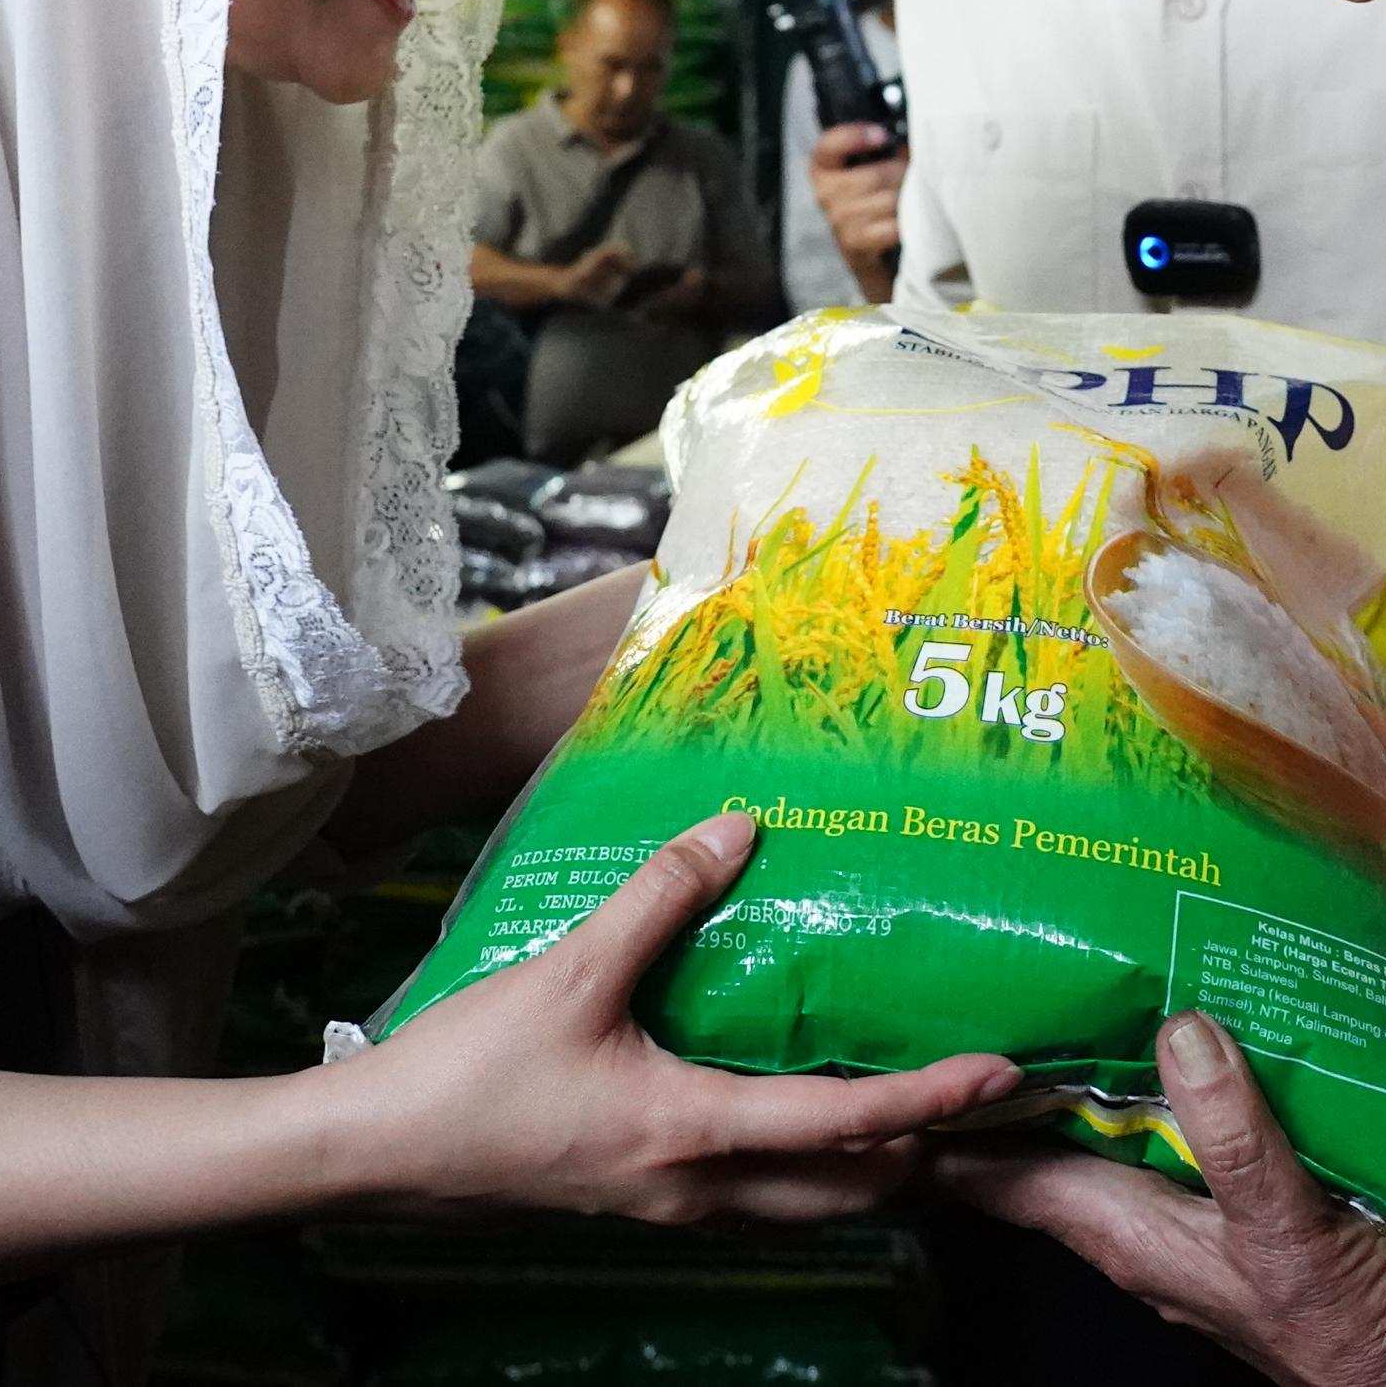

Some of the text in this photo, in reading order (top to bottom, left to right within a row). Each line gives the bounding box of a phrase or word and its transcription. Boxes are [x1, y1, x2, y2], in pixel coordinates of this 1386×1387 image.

[883, 608, 1110, 649] Berat Bersih/Netto:
[902, 640, 1069, 743] 5 kg
[900, 804, 1001, 846] Beras
[1010, 817, 1222, 887] Pemerintah
[502, 871, 558, 890] PERUM
[494, 897, 524, 914] JL.
[1251, 934, 1280, 953] HET
[1283, 944, 1328, 969] (Harga
[1257, 920, 1296, 943] Kelas
[1299, 933, 1332, 955] Mutu
[1343, 949, 1381, 974] Beras
[1239, 963, 1298, 989] Sulawesi
[1201, 971, 1266, 997] Sumatera
[1268, 988, 1320, 1014] (kecuali
[1322, 1005, 1382, 1039] Lampung
[1249, 1021, 1293, 1046] Papua
[1295, 1014, 1367, 1048] Kalimantan
